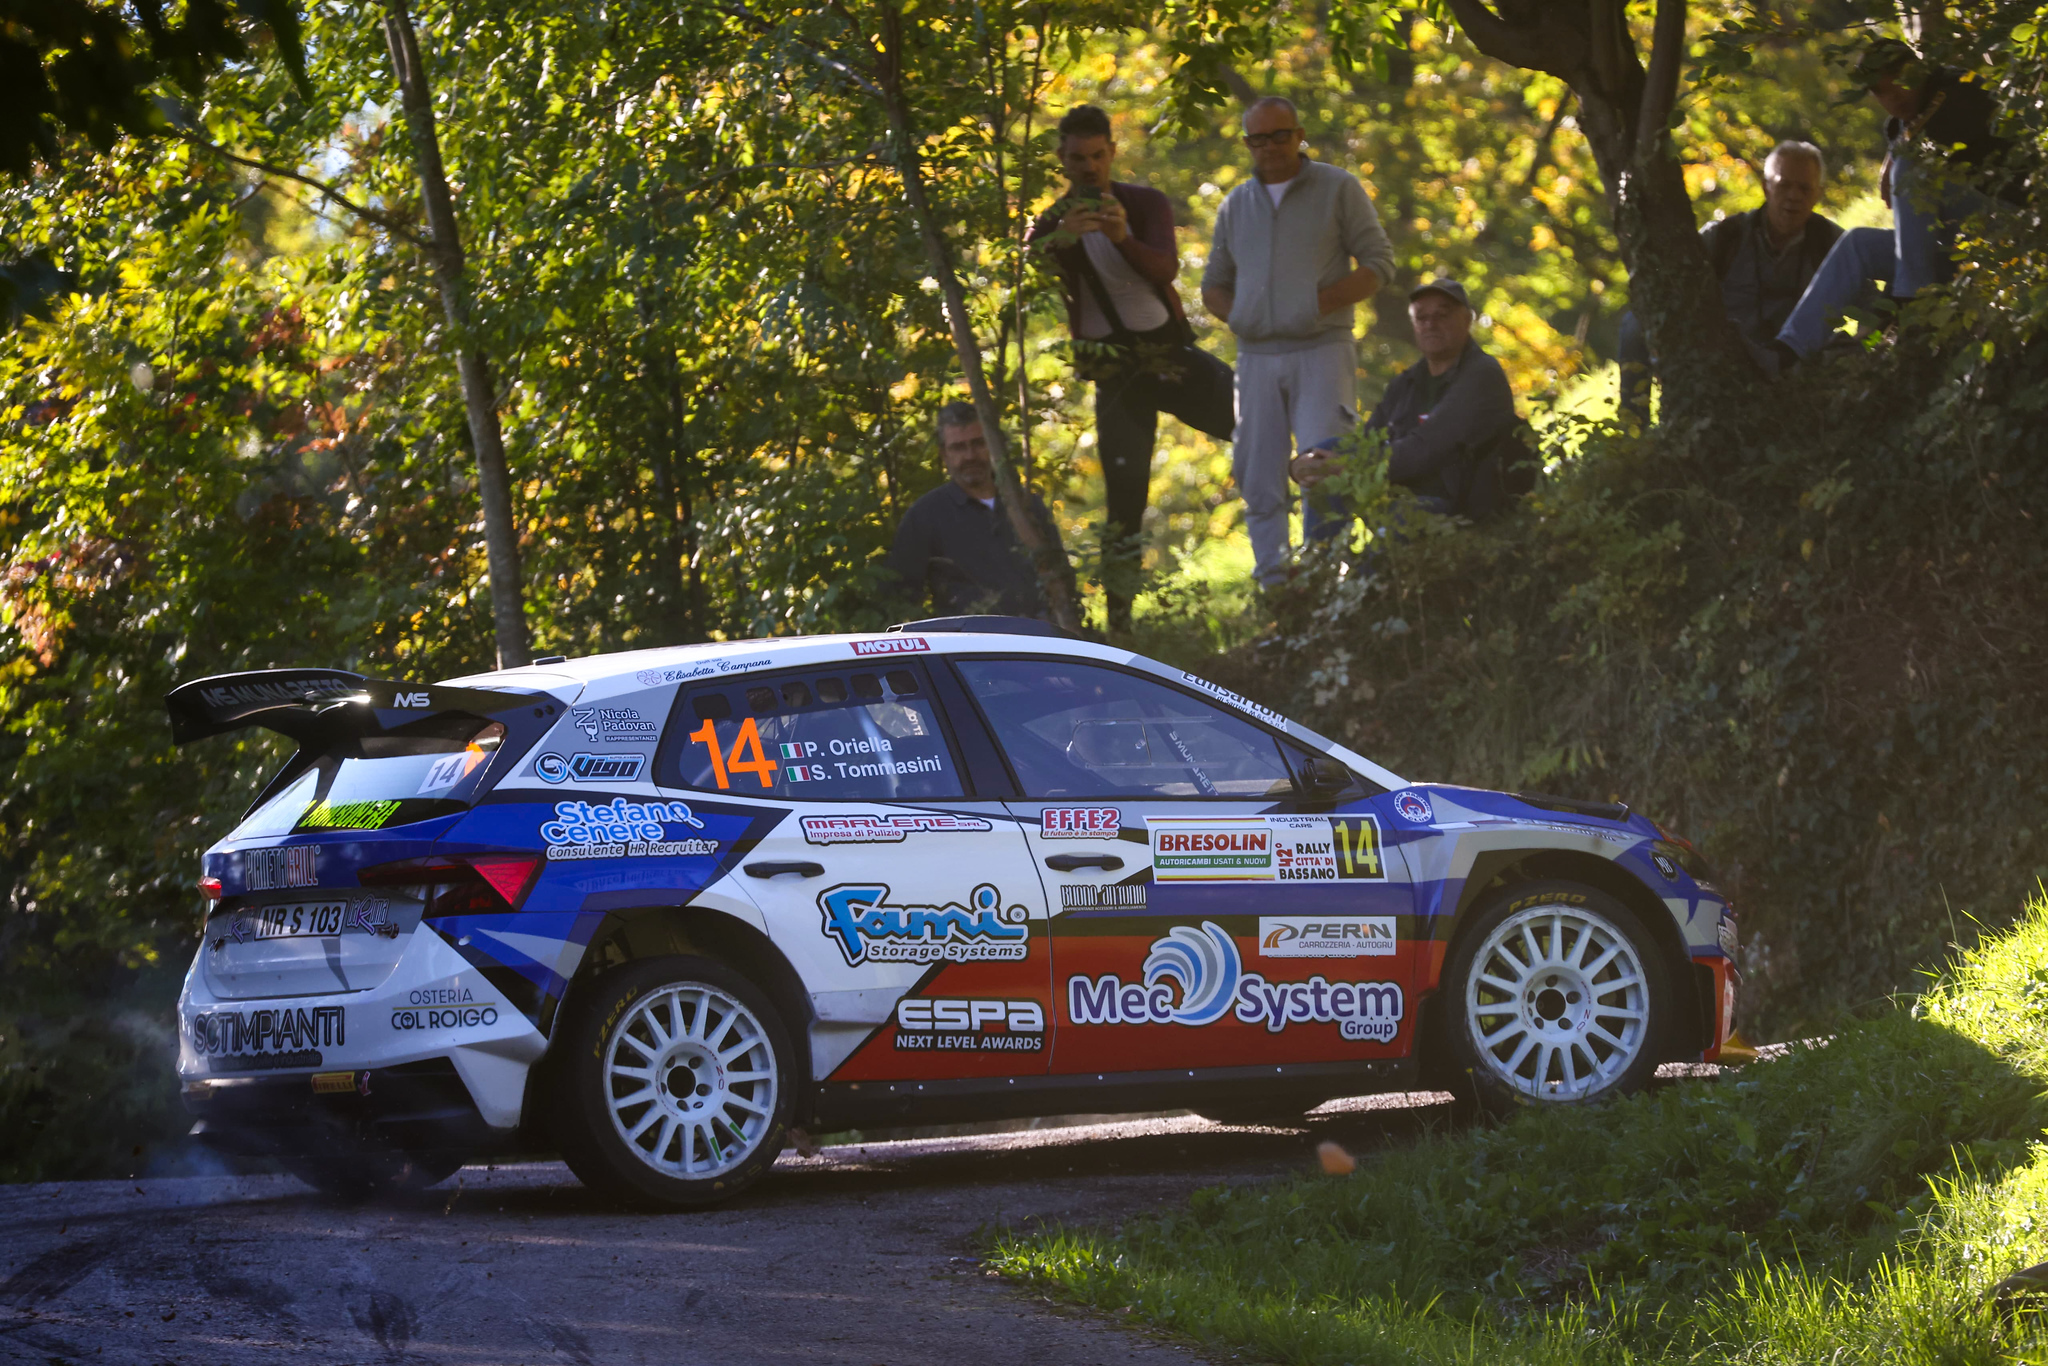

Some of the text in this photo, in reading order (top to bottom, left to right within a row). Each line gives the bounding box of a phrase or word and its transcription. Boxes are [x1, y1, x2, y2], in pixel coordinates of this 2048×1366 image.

[858, 638, 925, 654] MOTUL
[664, 658, 772, 682] Elisabetta Campana
[393, 692, 430, 708] MS
[600, 708, 639, 720] Nicola
[602, 720, 656, 732] Padovan
[690, 717, 778, 789] 14
[804, 736, 893, 758] P. Oriella
[428, 757, 463, 788] 14
[810, 755, 942, 781] S. Tommasini
[557, 798, 700, 827] Stefano
[1044, 810, 1118, 830] EFFE2
[543, 822, 662, 843] Cenere
[806, 818, 957, 830] MARLENE
[810, 828, 900, 840] Impresa di Pulizie
[1089, 830, 1116, 838] stampa
[1160, 834, 1266, 851] BRESOLIN
[548, 840, 718, 858] Consulente HR Recruiter
[1296, 843, 1330, 854] RALLY
[1335, 820, 1378, 874] 14
[1160, 858, 1212, 866] AUTORICAMBI
[1296, 857, 1334, 866] CITTA' DI
[1279, 868, 1336, 880] BASSANO
[260, 906, 287, 936] NR
[290, 906, 304, 934] S
[308, 905, 342, 934] 103
[824, 888, 1024, 954] Fami
[1300, 924, 1392, 939] PERIN
[870, 946, 1024, 960] Storage Systems
[1299, 941, 1351, 949] CARROZZERIA
[1356, 941, 1393, 949] AUTOGRU
[410, 988, 474, 1005] OSTERIA
[1073, 979, 1172, 1019] Mec
[1239, 978, 1400, 1028] System
[392, 1008, 498, 1030] COL ROIGO
[1344, 1020, 1394, 1038] Group
[896, 1034, 1042, 1050] NEXT LEVEL AWARDS
